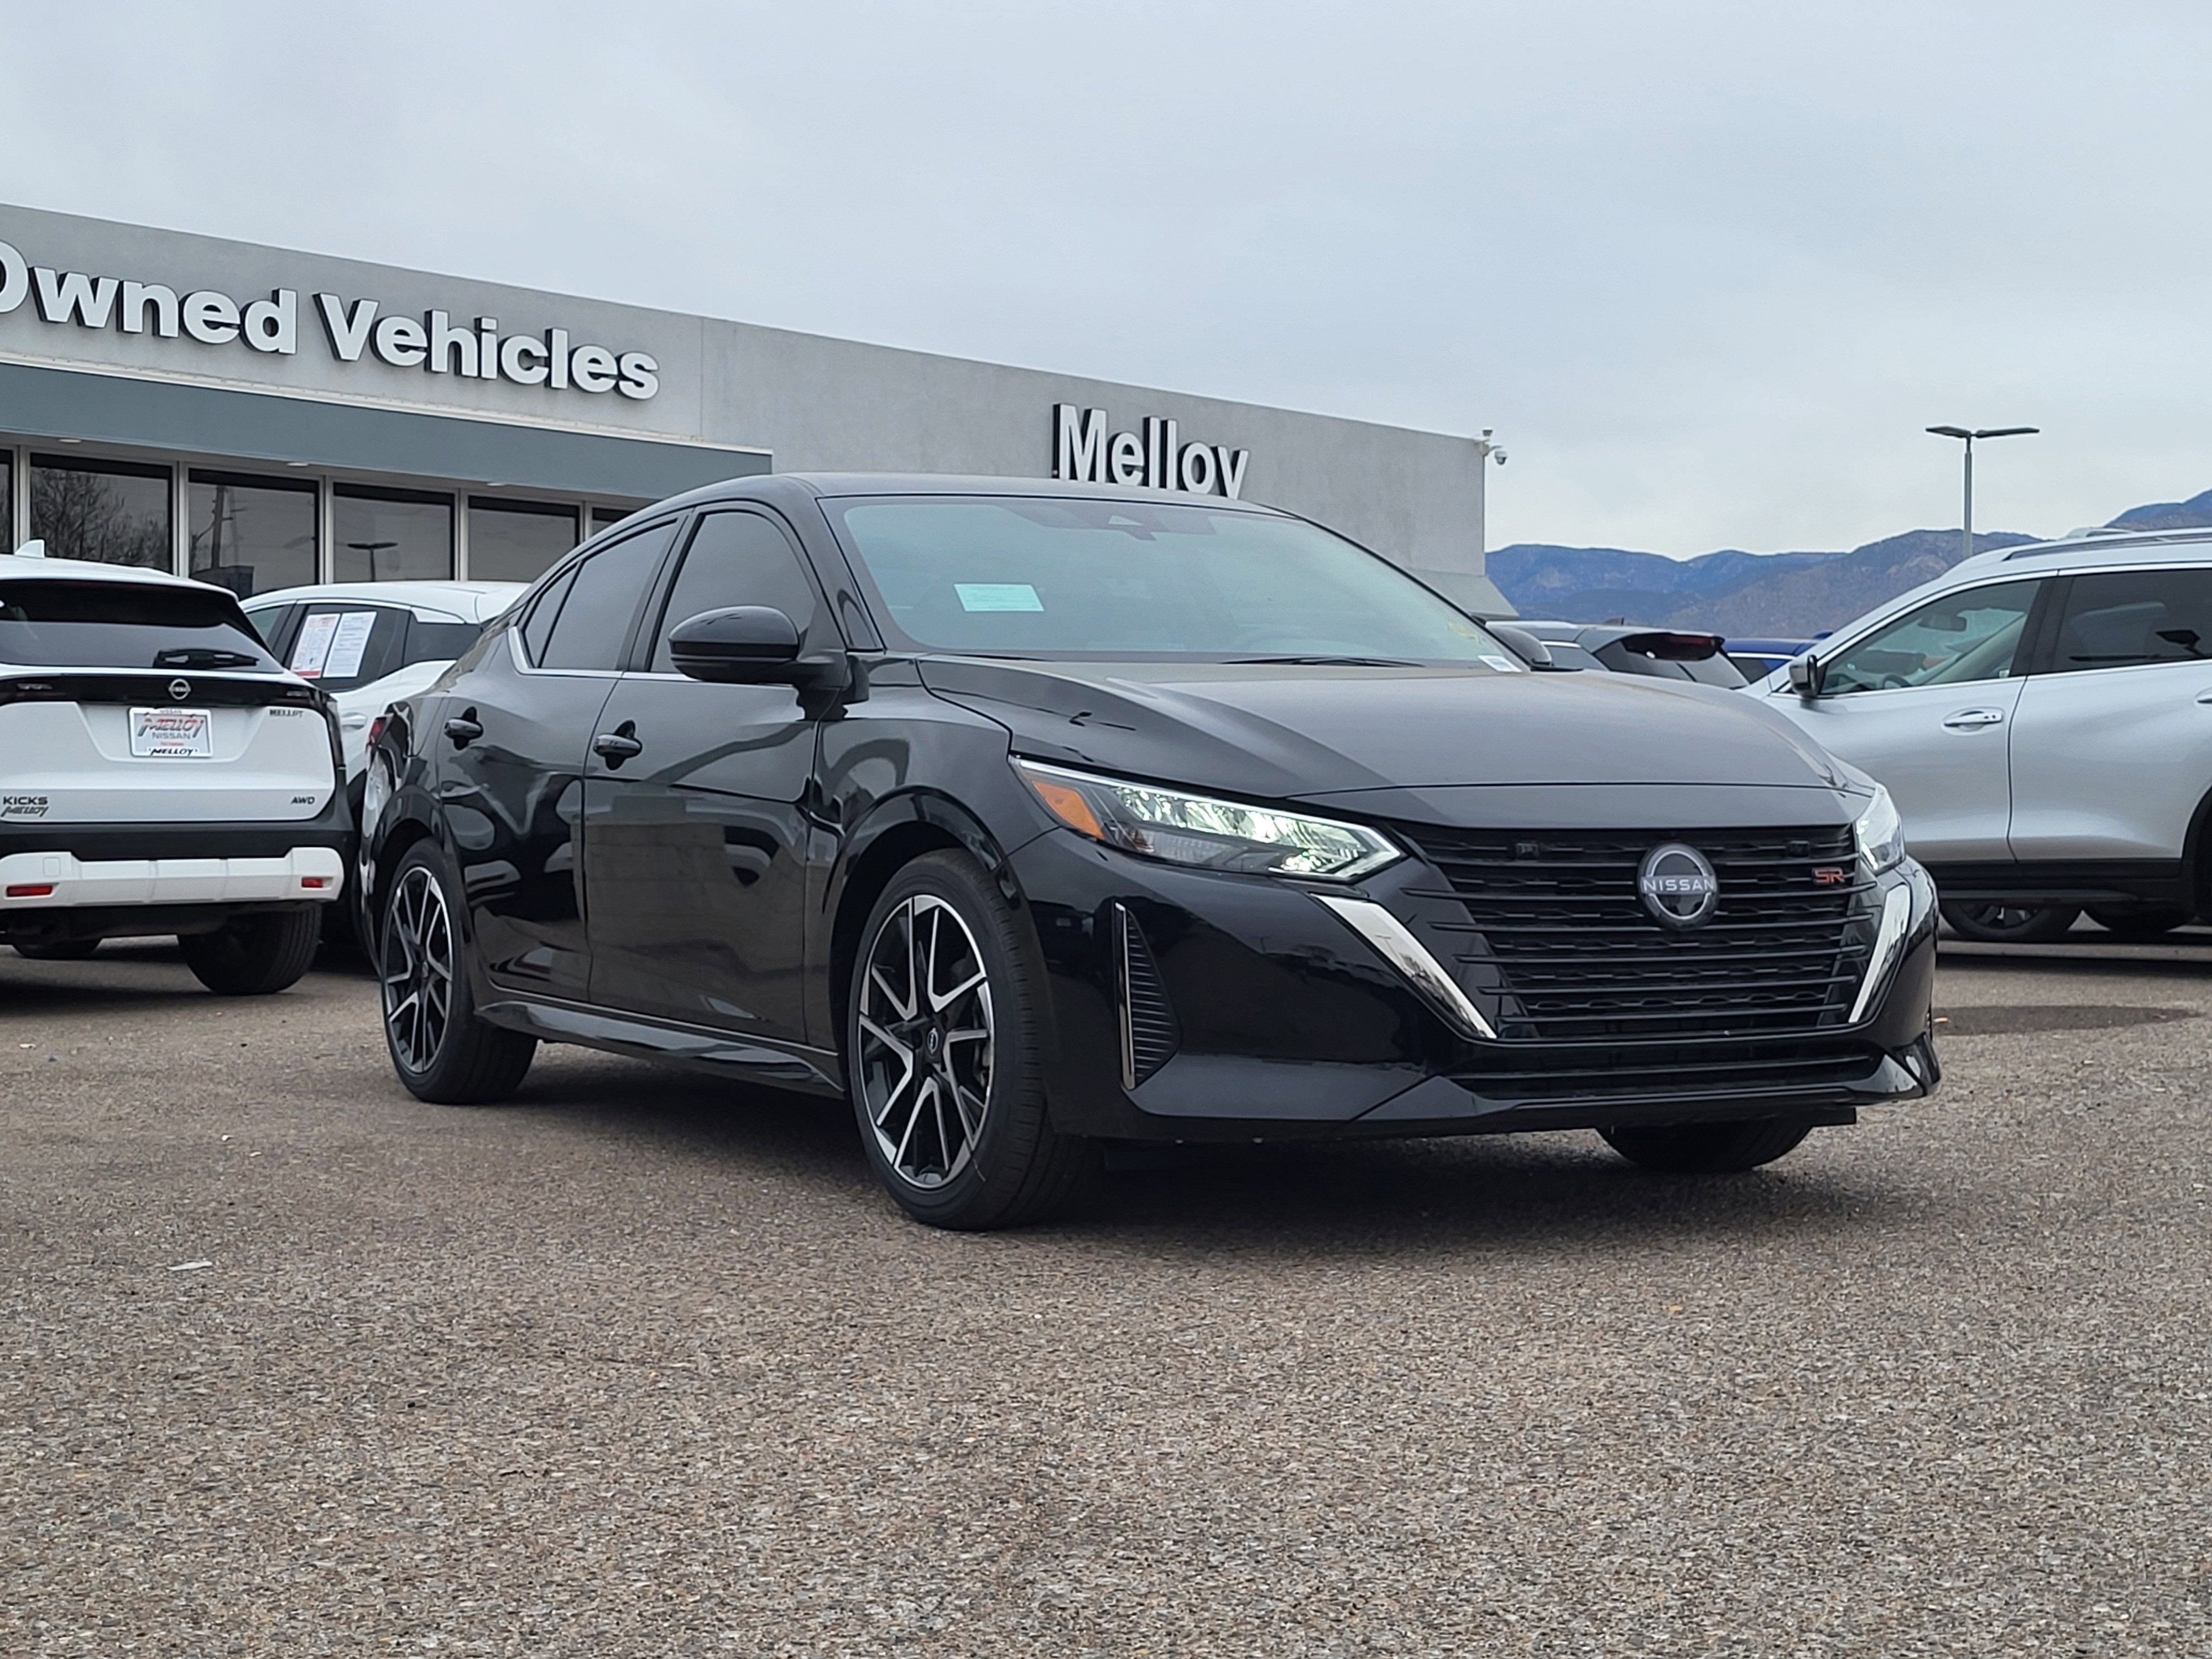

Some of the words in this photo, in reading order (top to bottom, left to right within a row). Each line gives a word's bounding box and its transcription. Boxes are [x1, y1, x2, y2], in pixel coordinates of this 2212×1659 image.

[313, 292, 659, 400] Vehicles
[150, 748, 194, 757] MELLOY
[3, 796, 48, 805] KICKS
[291, 796, 315, 805] AWD
[1814, 868, 1845, 884] SR
[1643, 879, 1714, 891] NISSAN
